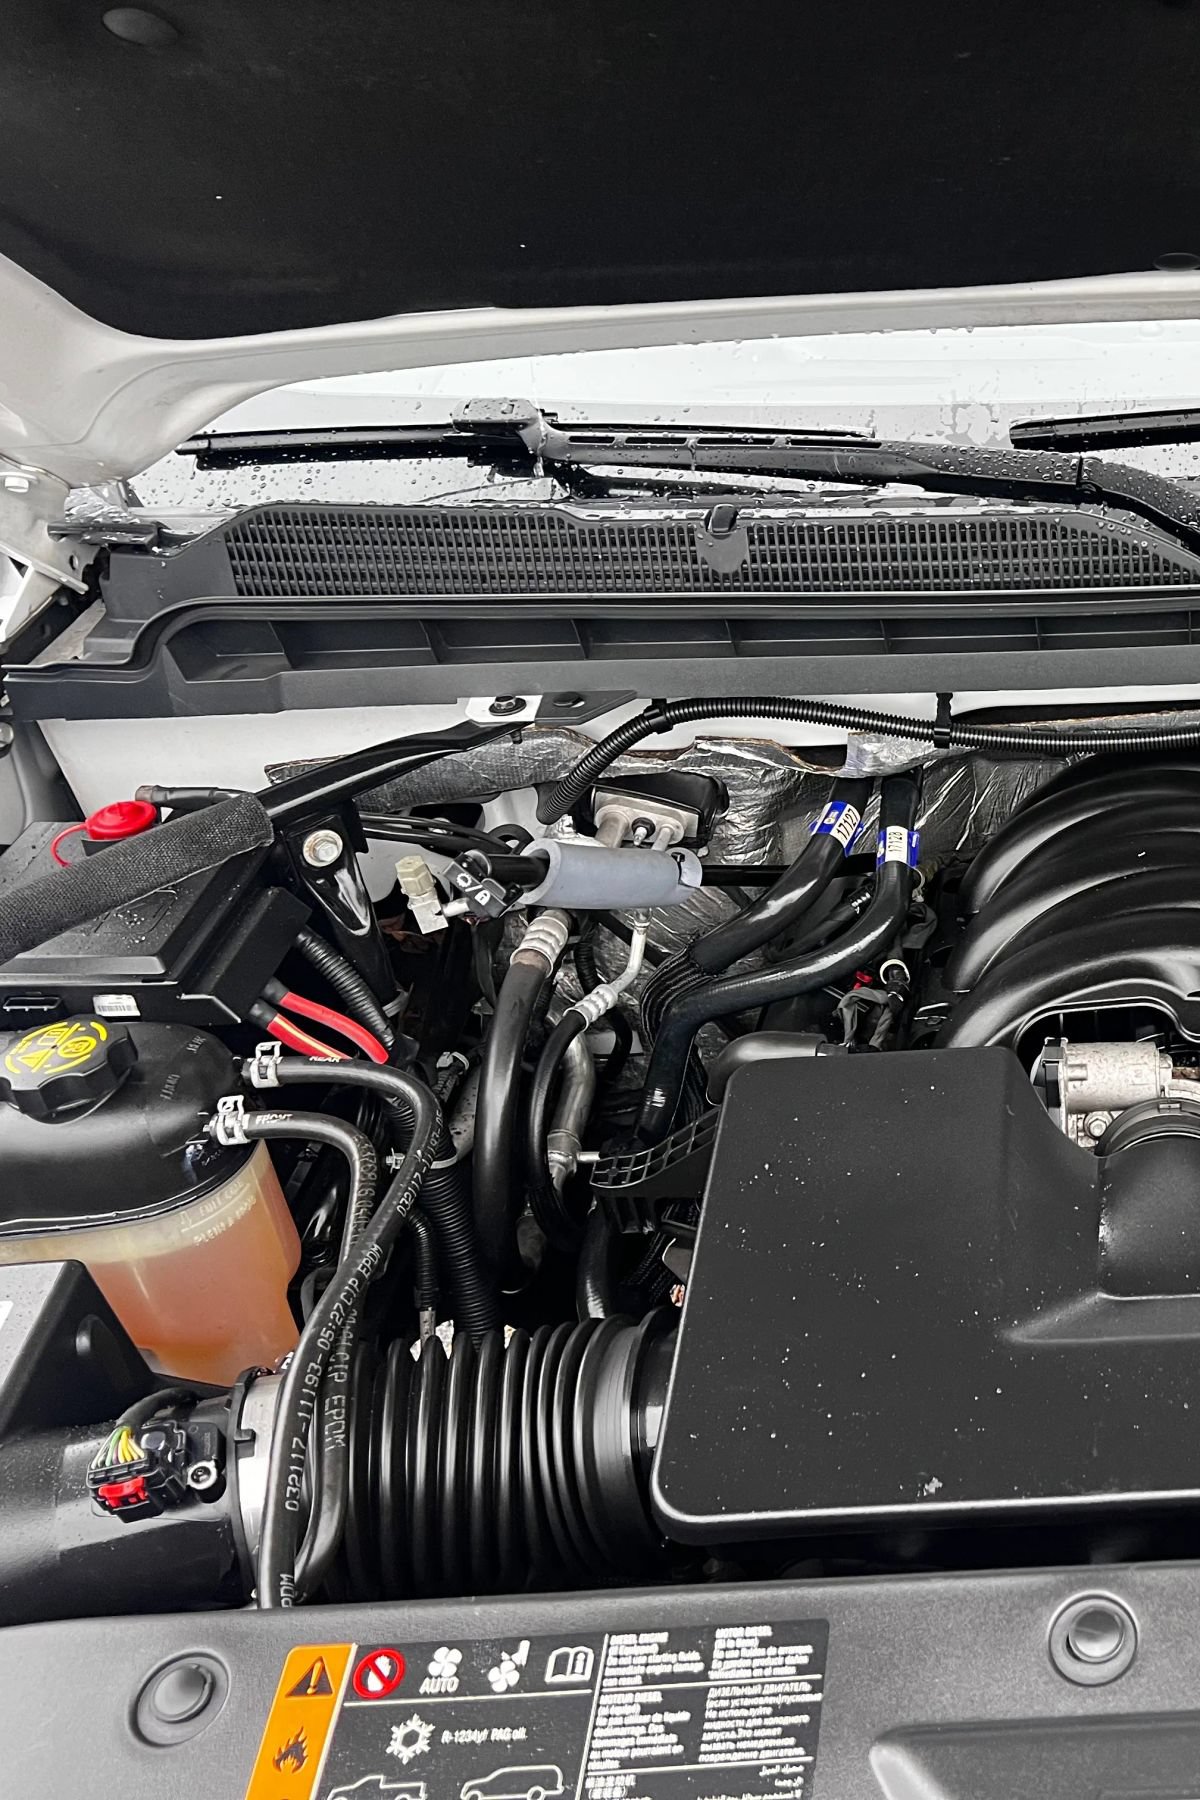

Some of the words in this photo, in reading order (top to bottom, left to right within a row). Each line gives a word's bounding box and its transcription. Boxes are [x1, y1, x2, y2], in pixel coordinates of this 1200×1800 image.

[836, 807, 859, 841] 17127
[888, 831, 903, 852] 17128
[255, 1113, 293, 1125] FRONT
[355, 1243, 384, 1279] EPDM
[279, 1573, 295, 1609] PDM
[419, 1676, 460, 1695] AUTO
[707, 1684, 762, 1698] ДИЗЕЛЬНЫЙ
[762, 1682, 812, 1695] ДВИГАТЕЛЬ
[705, 1709, 717, 1719] Не
[718, 1706, 773, 1718] используйте
[441, 1729, 489, 1744] R-1234yf
[490, 1727, 512, 1742] PAG
